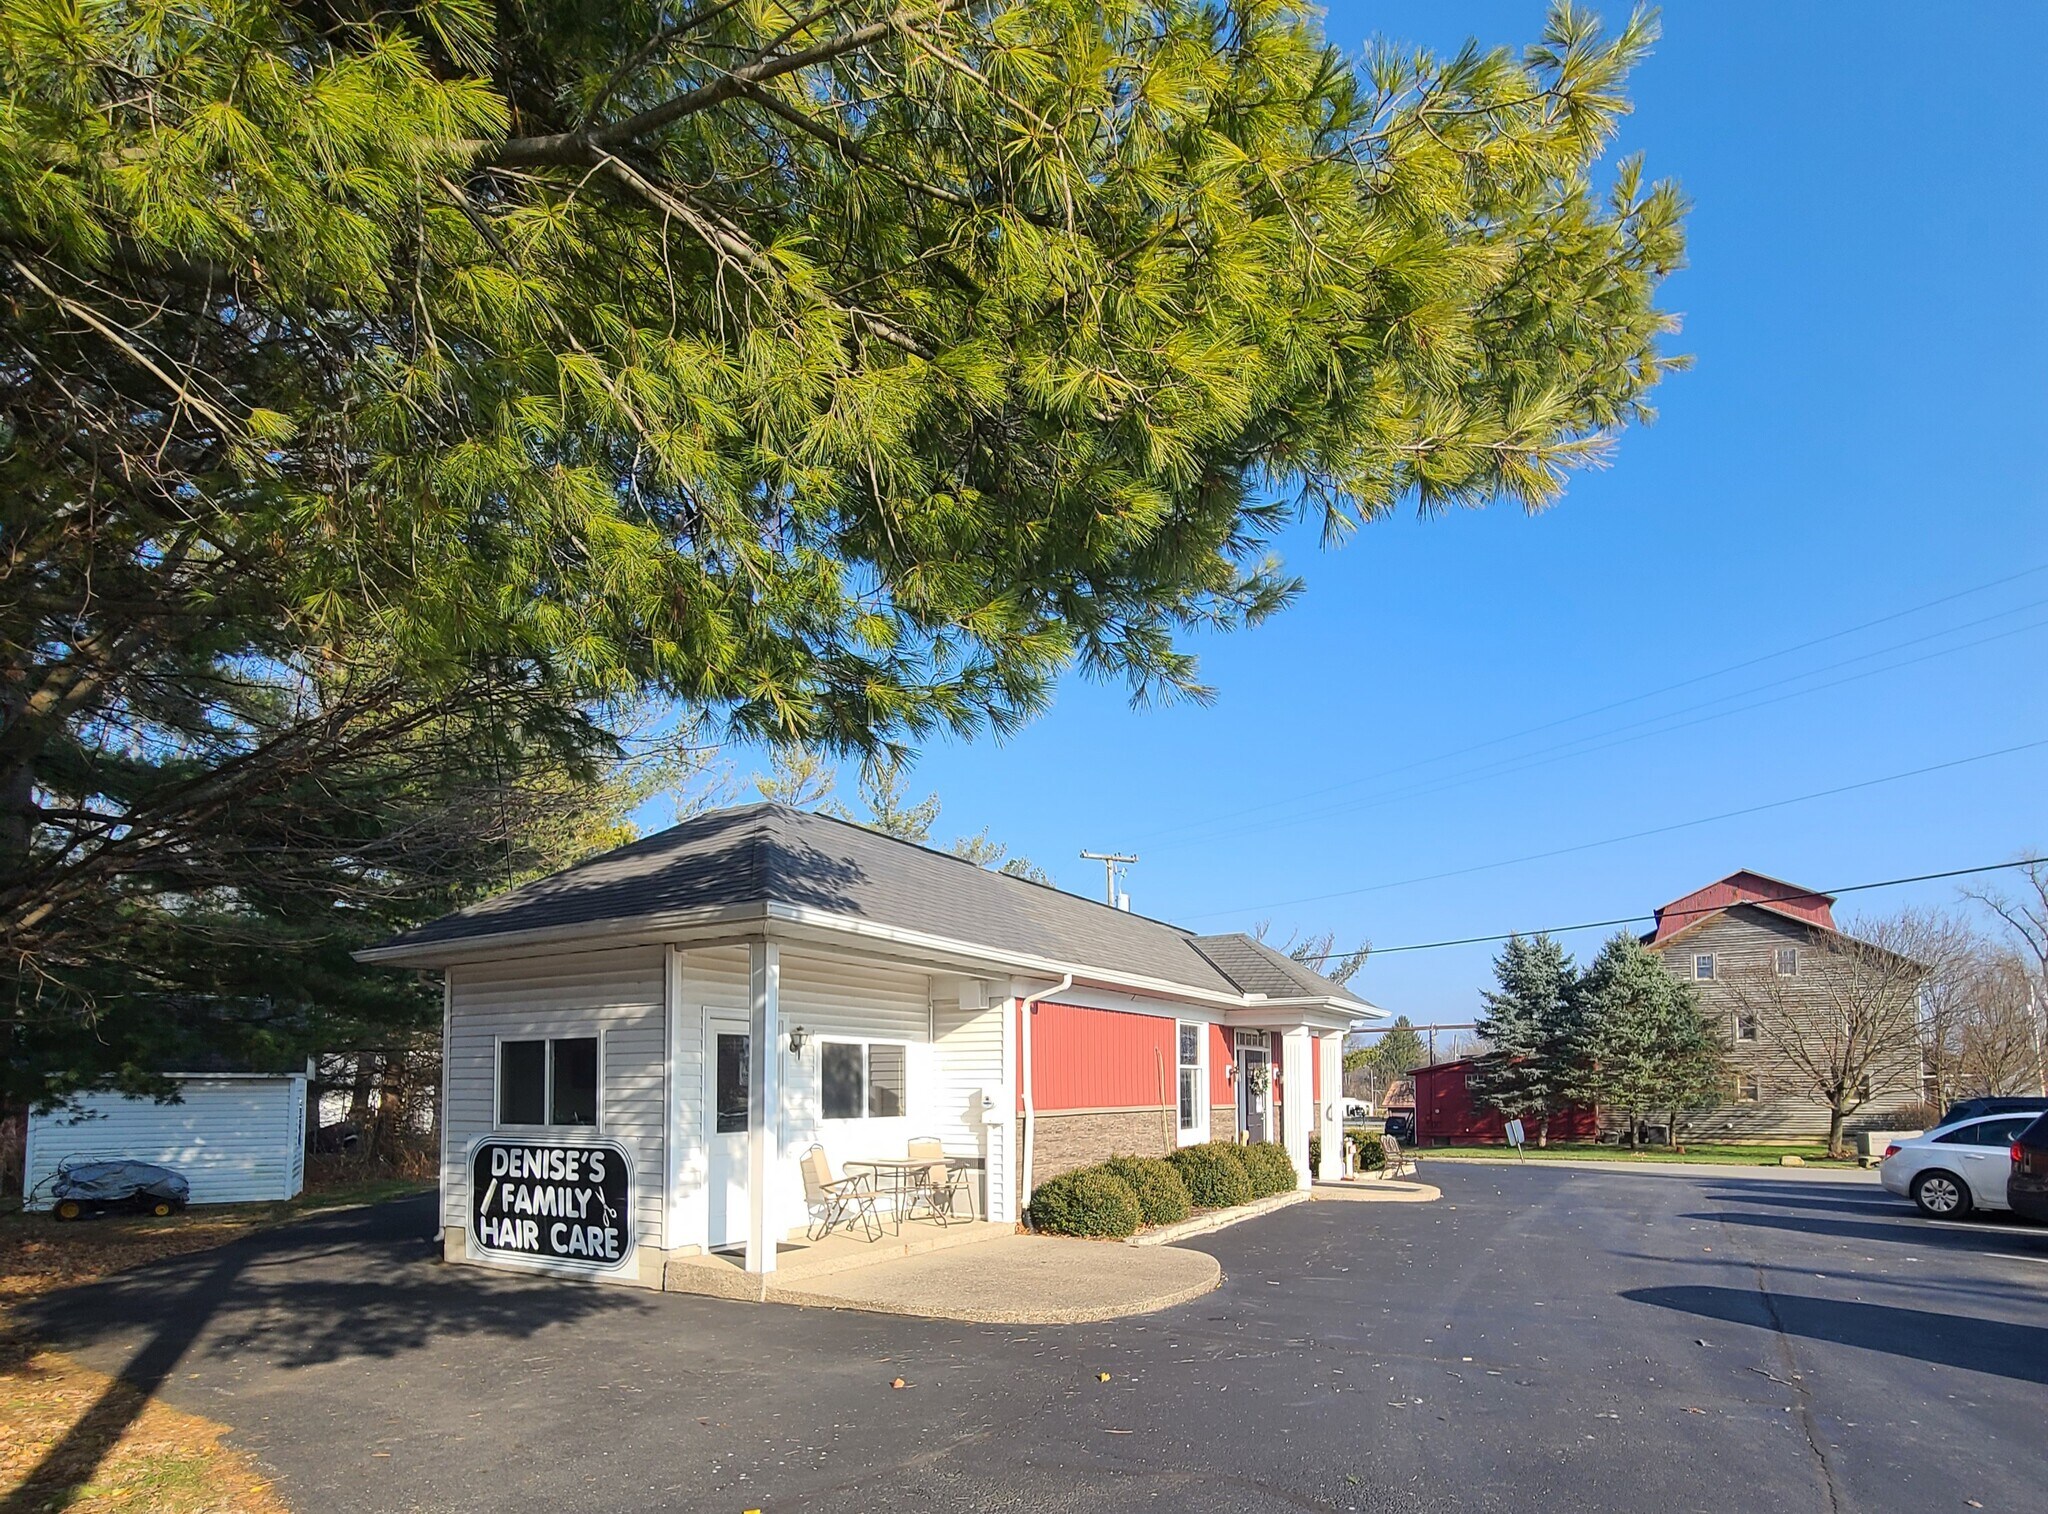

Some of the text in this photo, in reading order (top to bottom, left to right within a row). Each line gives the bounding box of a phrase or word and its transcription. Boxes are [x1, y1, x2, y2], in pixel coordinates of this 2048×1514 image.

[491, 1148, 606, 1183] DENISE'S
[502, 1183, 592, 1219] FAMILY
[480, 1216, 620, 1259] HAIR CARE
